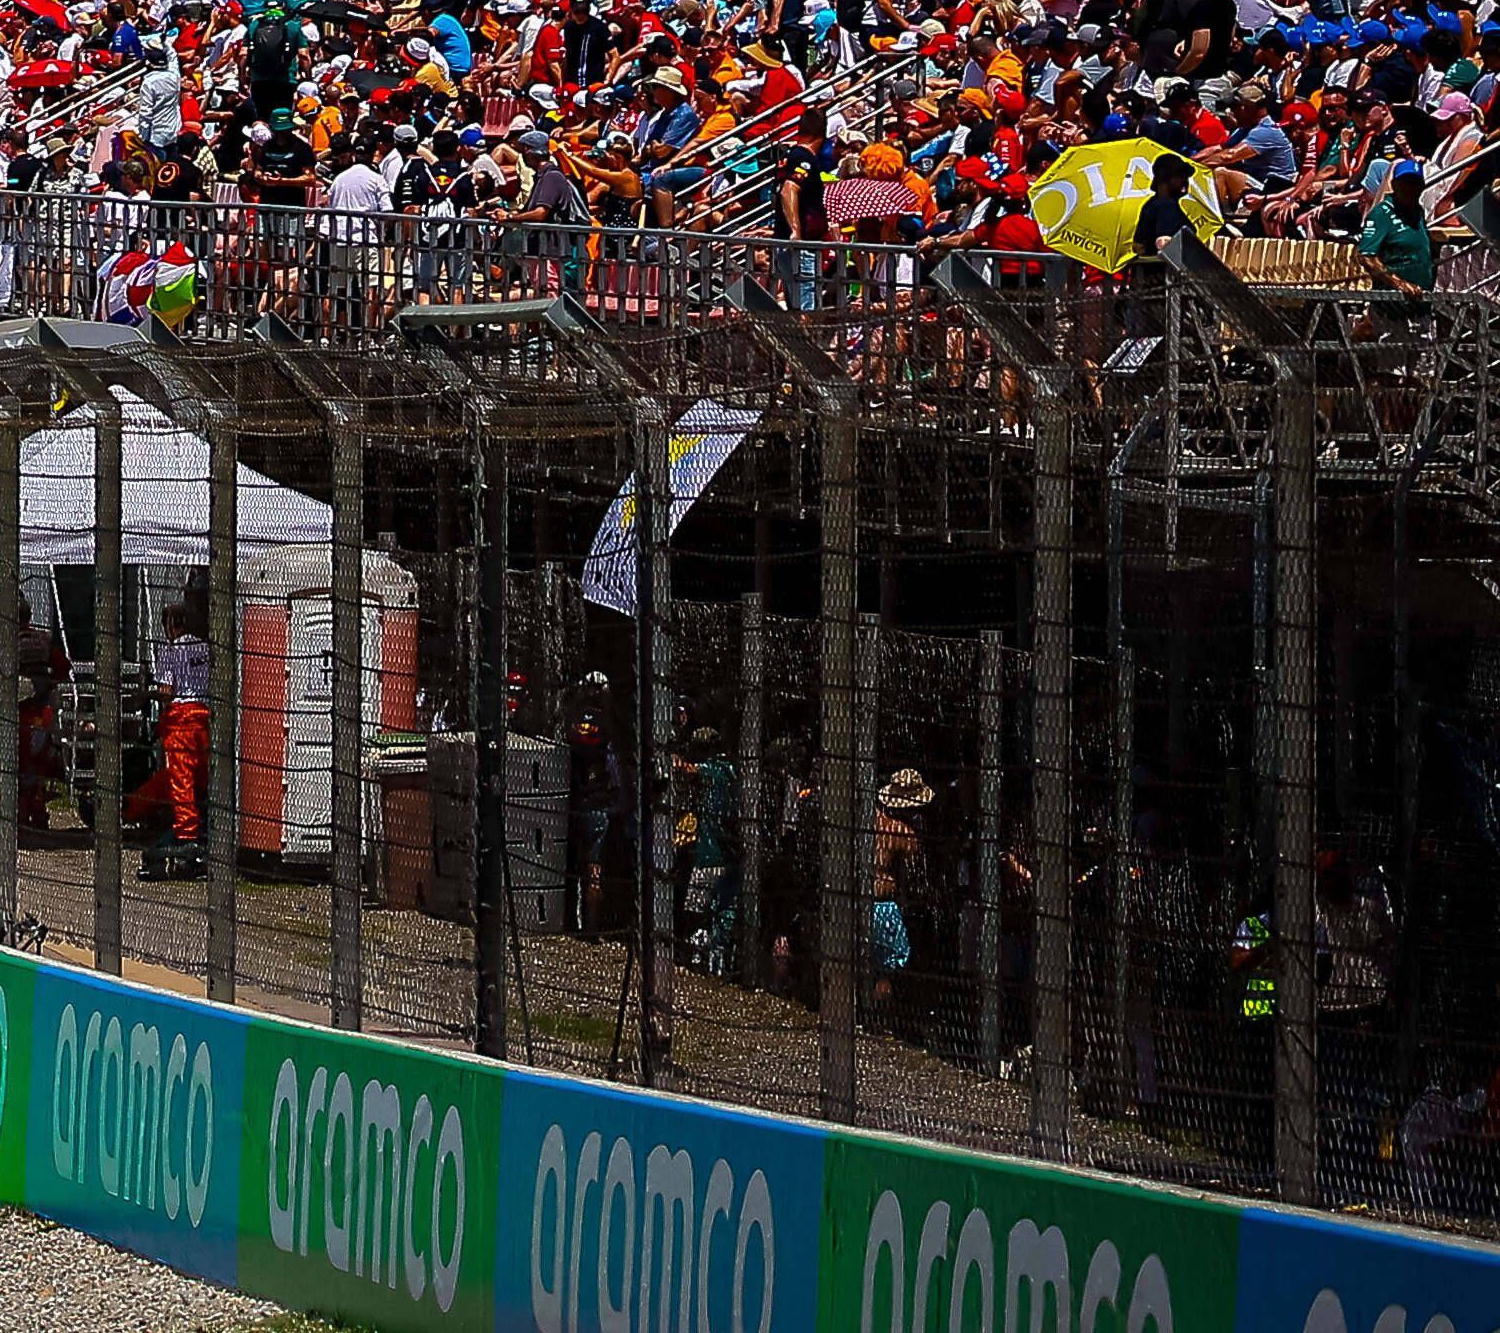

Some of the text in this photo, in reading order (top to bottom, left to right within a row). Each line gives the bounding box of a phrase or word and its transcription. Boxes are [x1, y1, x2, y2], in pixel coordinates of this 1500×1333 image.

[1060, 228, 1108, 258] INVICTA
[52, 1003, 215, 1228] aramco
[268, 1058, 466, 1313] aramco
[531, 1124, 775, 1333] aramco
